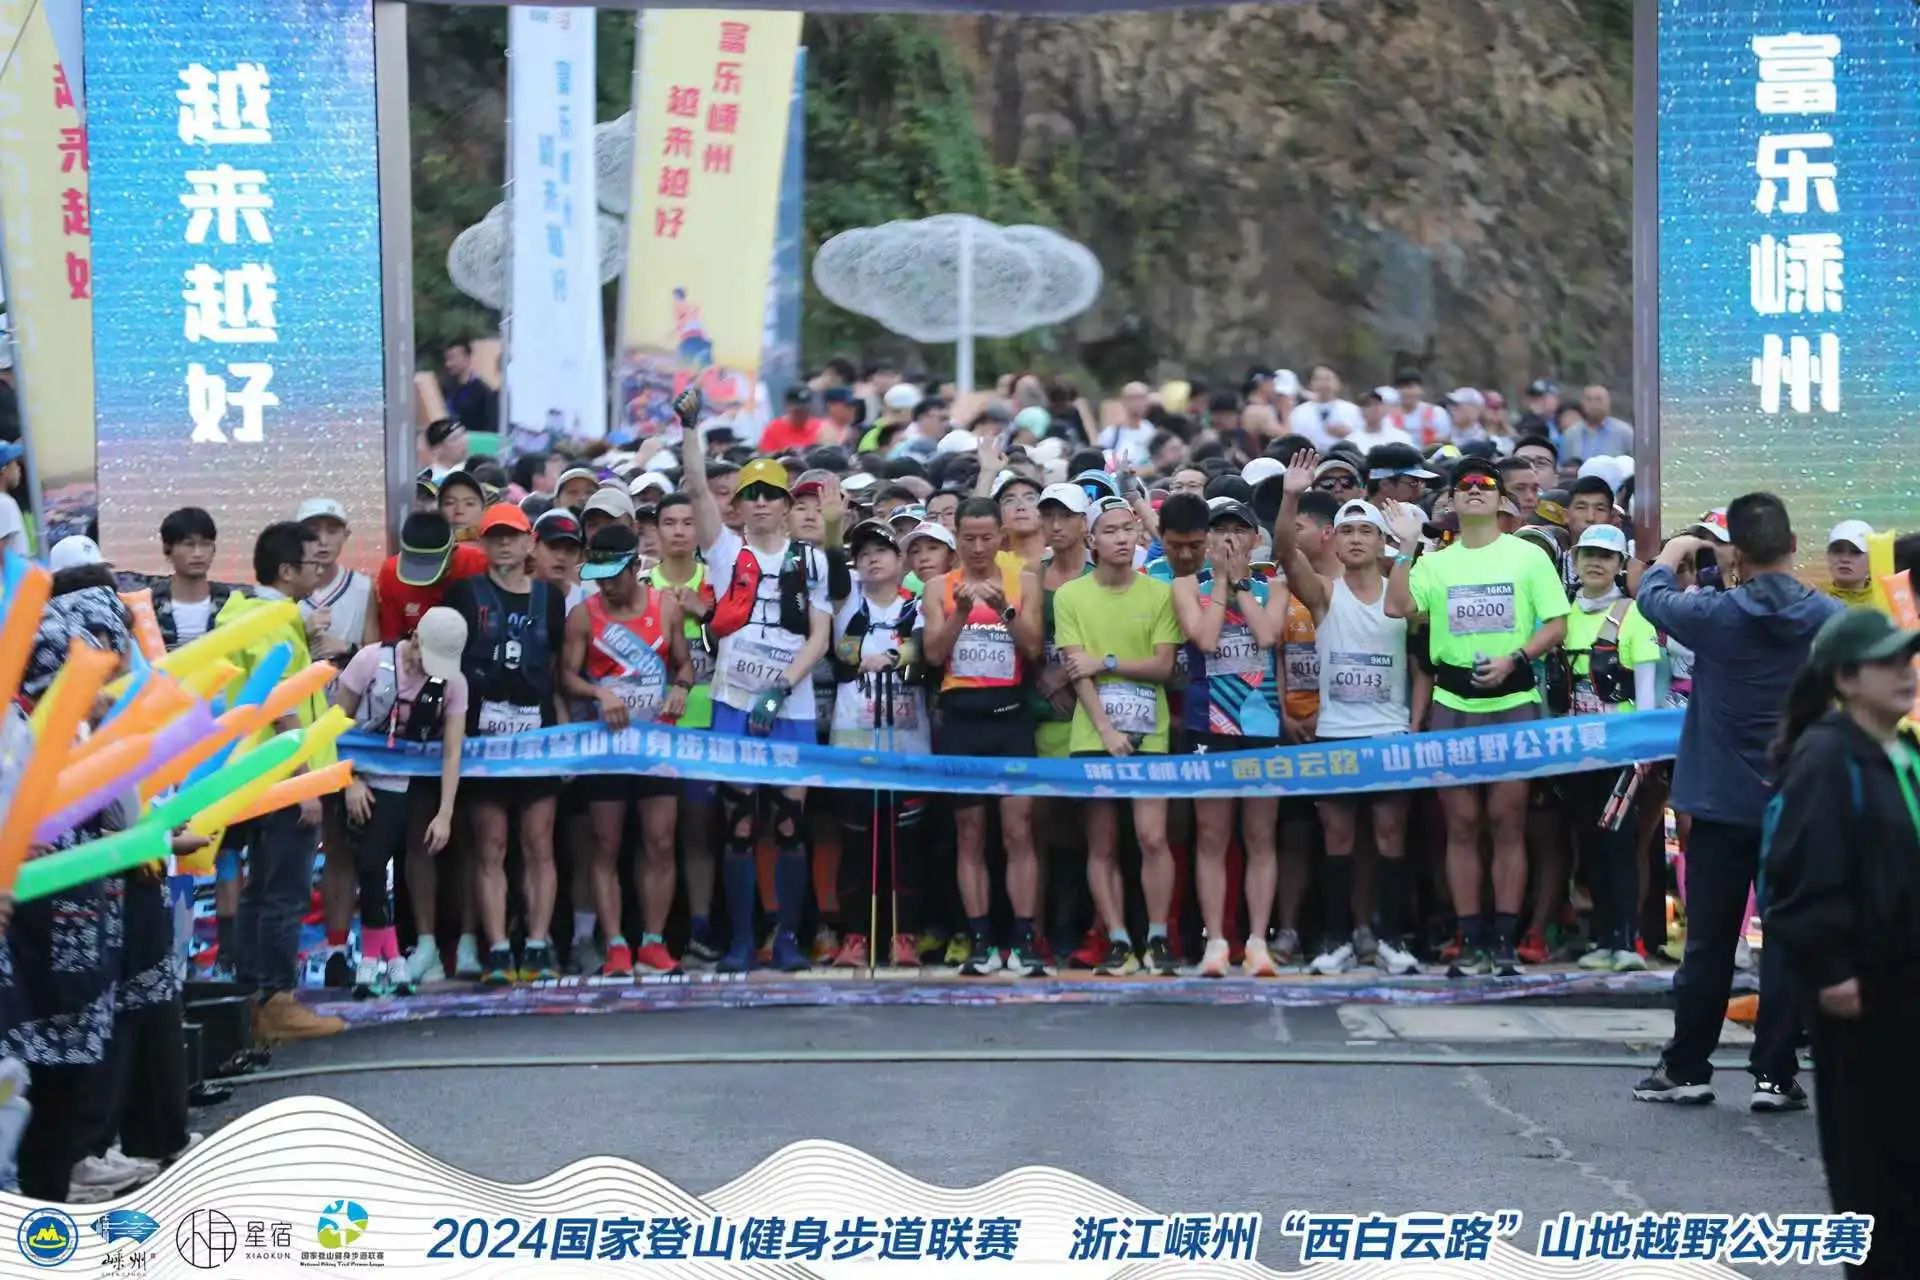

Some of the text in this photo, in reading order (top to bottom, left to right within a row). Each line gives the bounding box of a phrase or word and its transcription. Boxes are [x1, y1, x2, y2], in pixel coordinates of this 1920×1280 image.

[703, 21, 750, 174] 富乐嵊州
[655, 84, 700, 239] 越来越好
[1750, 32, 1844, 413] 富乐嵊州
[176, 62, 280, 444] 越来越好
[1486, 585, 1512, 594] 16KM
[1456, 603, 1505, 618] B0200
[736, 660, 784, 681] B0177
[1336, 672, 1382, 687] C0143
[1105, 702, 1150, 720] B0272
